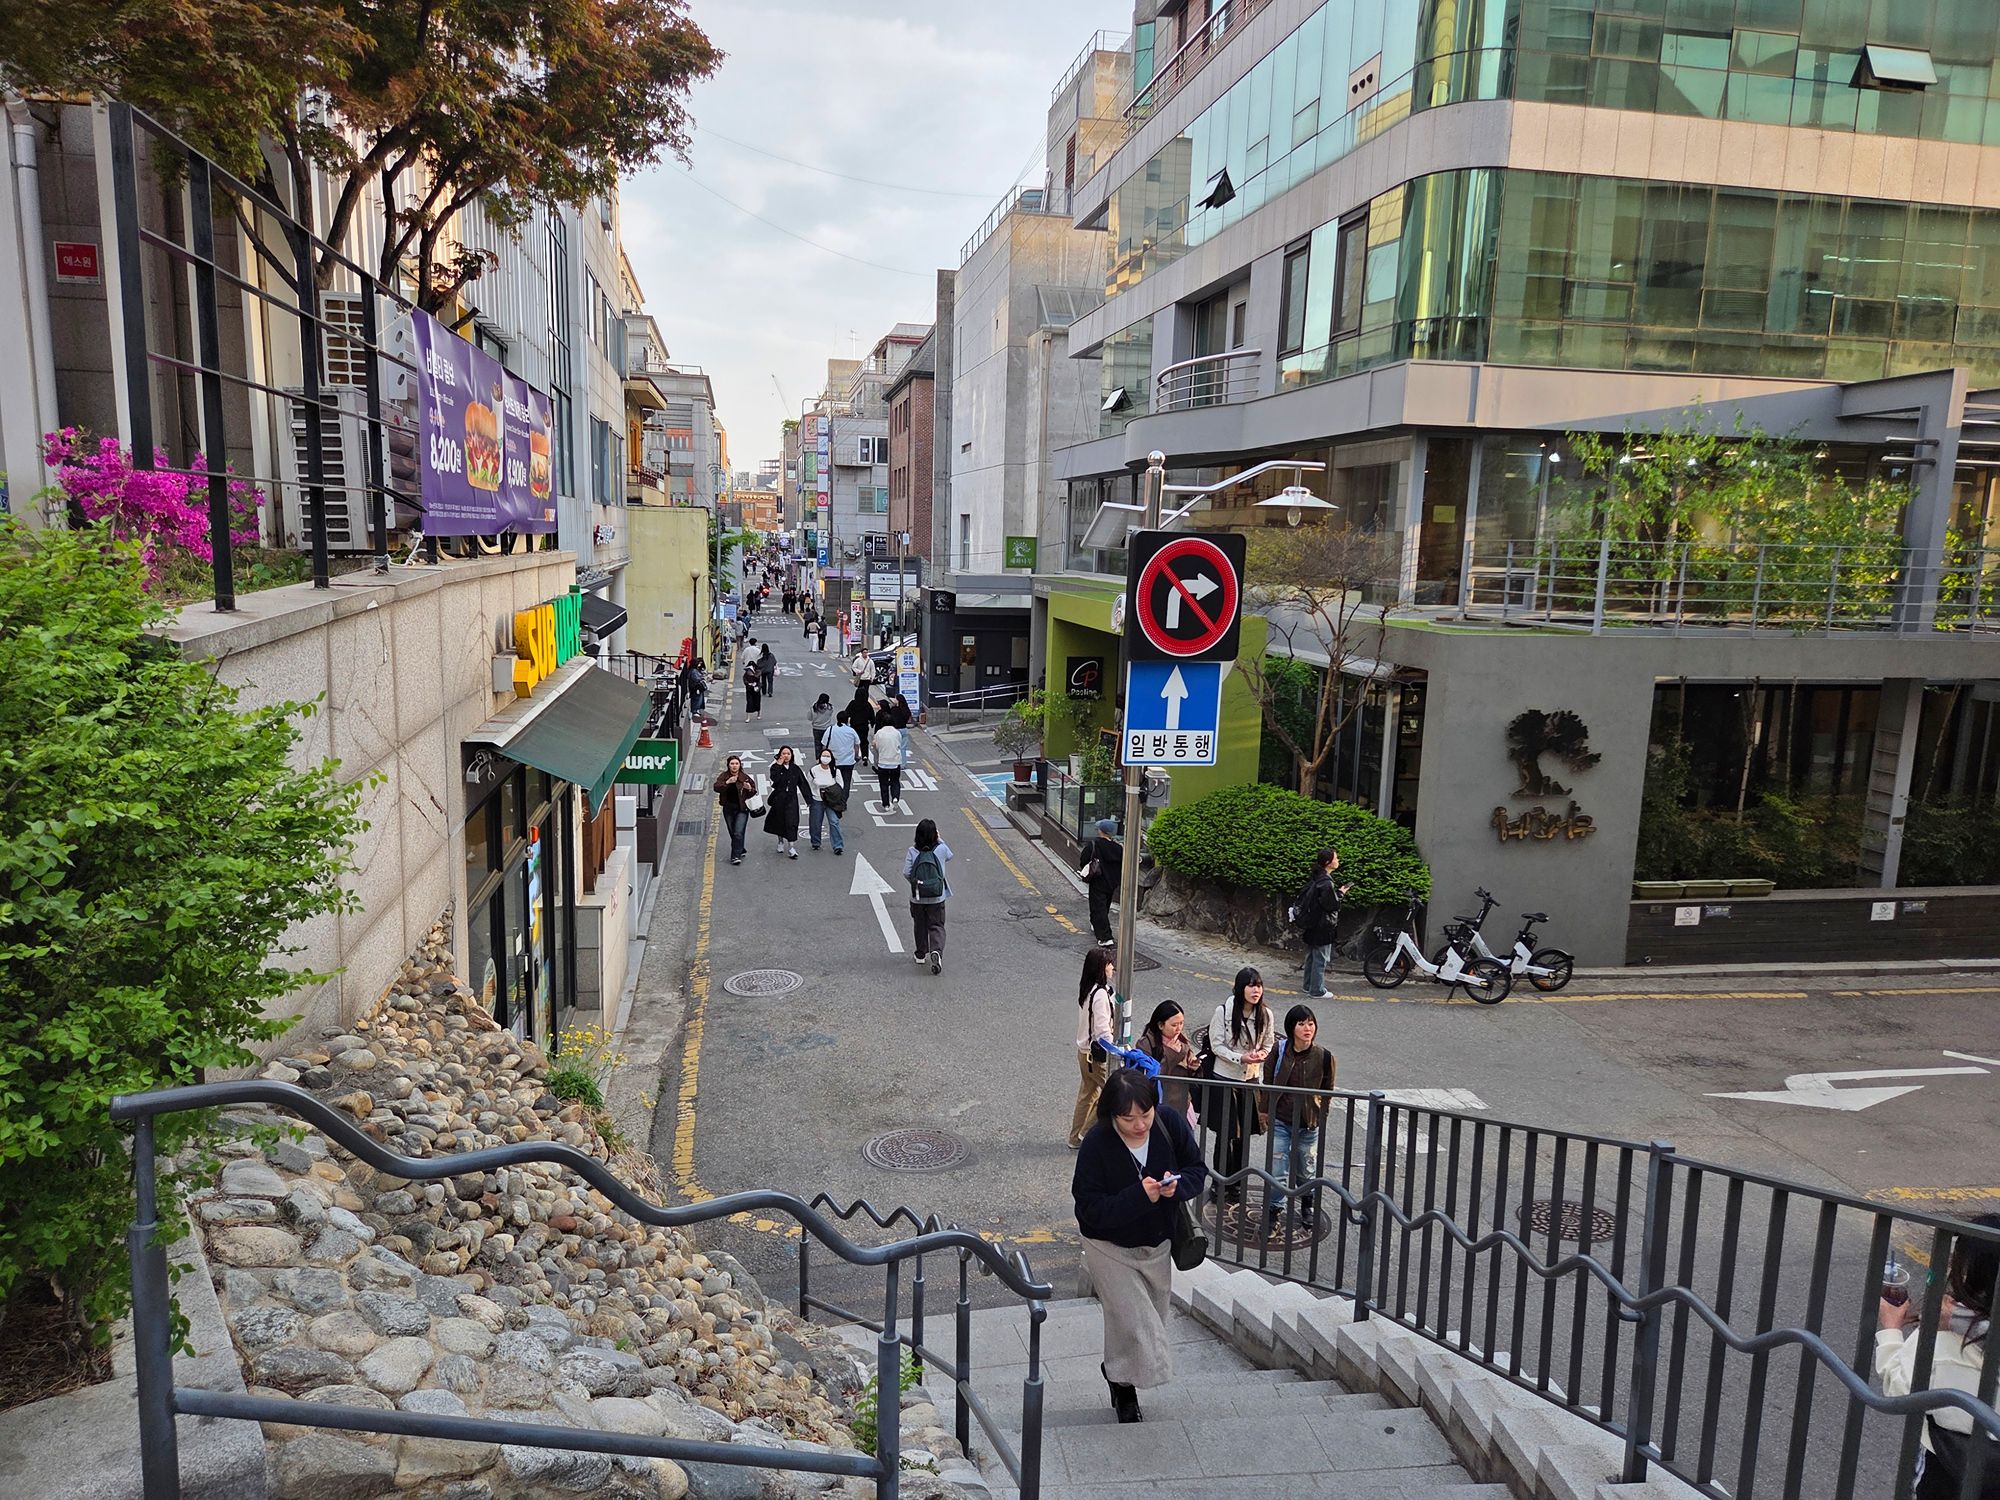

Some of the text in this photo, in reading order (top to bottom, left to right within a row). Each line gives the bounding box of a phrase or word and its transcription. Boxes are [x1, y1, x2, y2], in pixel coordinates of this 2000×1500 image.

[63, 255, 92, 268] 에스원
[430, 433, 462, 476] 8,200원
[1131, 734, 1211, 758] 일방통행
